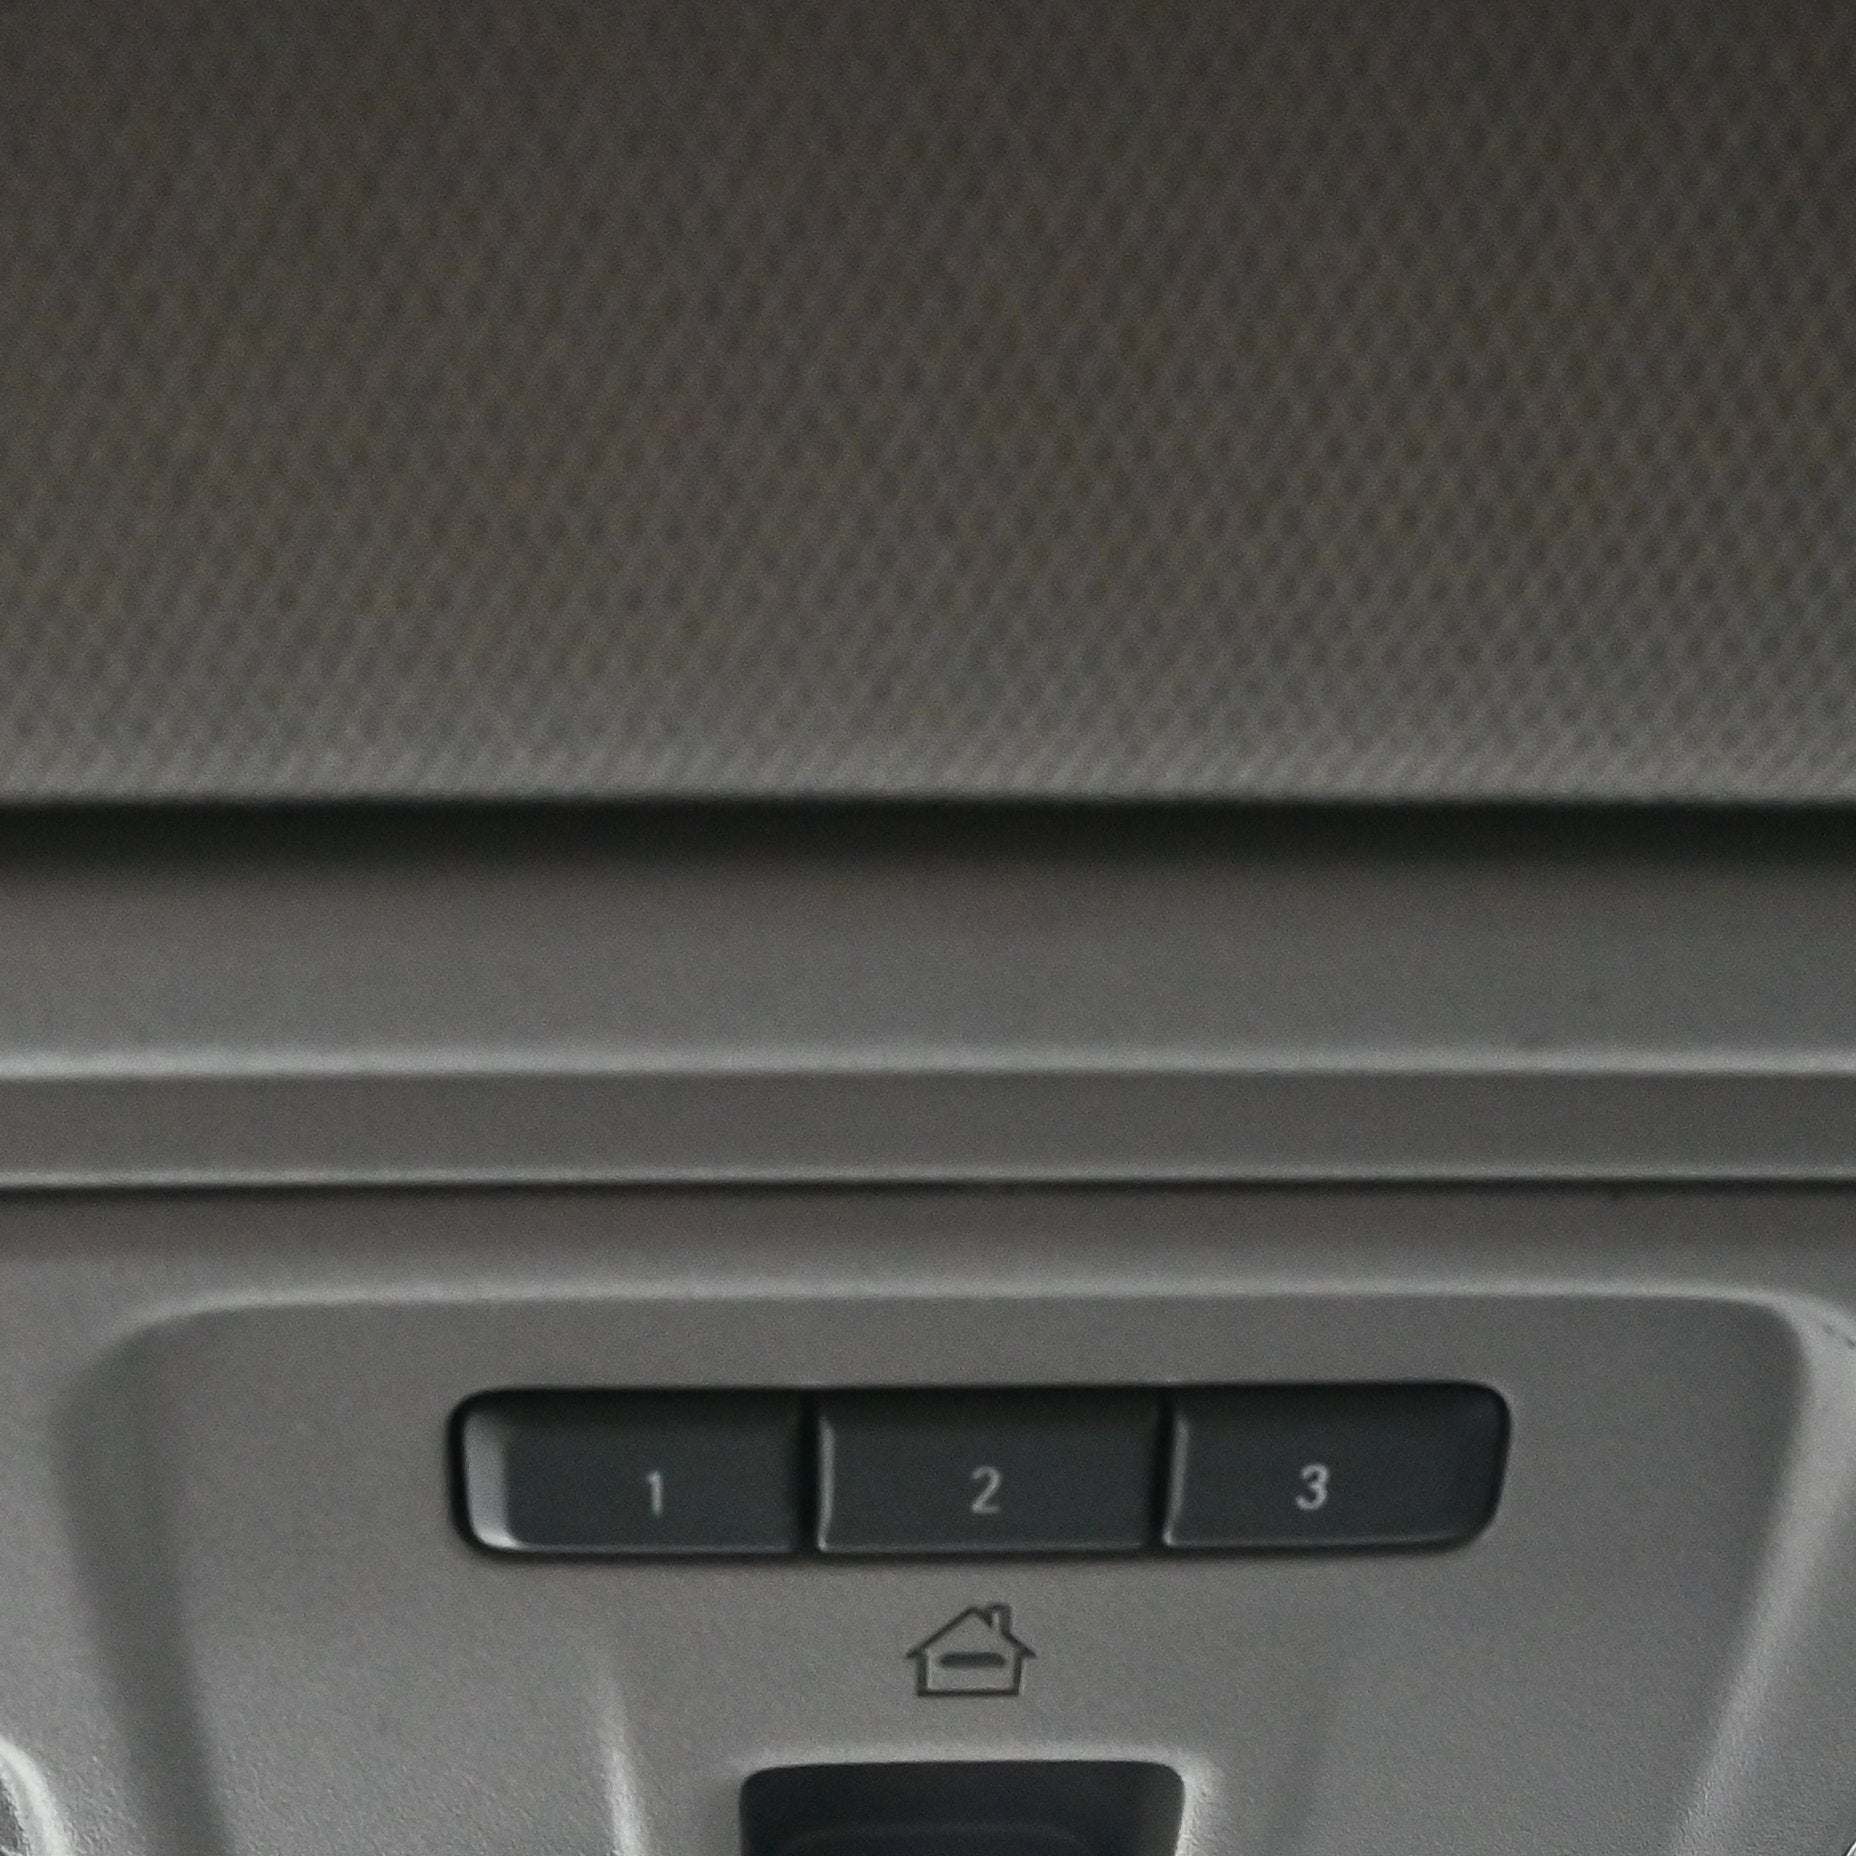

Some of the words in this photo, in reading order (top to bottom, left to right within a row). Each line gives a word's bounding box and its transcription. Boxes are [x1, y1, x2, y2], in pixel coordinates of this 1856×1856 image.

[646, 1470, 664, 1515] 1
[970, 1465, 1003, 1514] 2
[1294, 1464, 1331, 1511] 3
